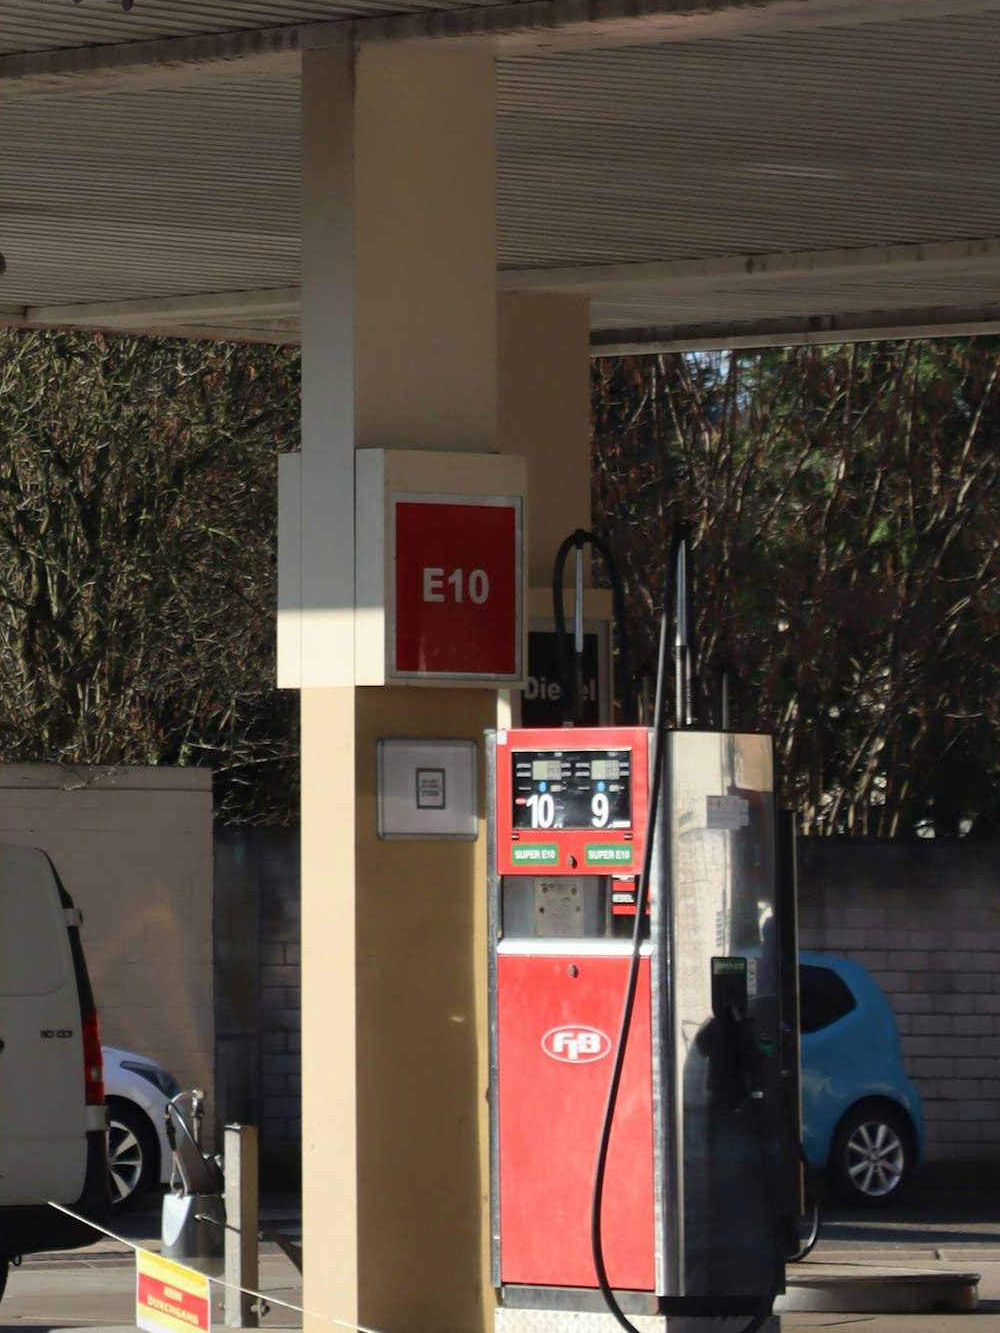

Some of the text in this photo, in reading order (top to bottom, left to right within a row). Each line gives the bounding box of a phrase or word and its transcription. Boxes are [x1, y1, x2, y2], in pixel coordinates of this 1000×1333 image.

[422, 567, 490, 605] E10
[524, 677, 596, 701] Diel
[526, 794, 555, 828] 10
[591, 793, 609, 828] 9
[514, 850, 556, 860] SUPER E10
[588, 850, 630, 860] SUPER E10
[552, 1032, 601, 1060] FTB
[163, 1285, 183, 1303] KEIN
